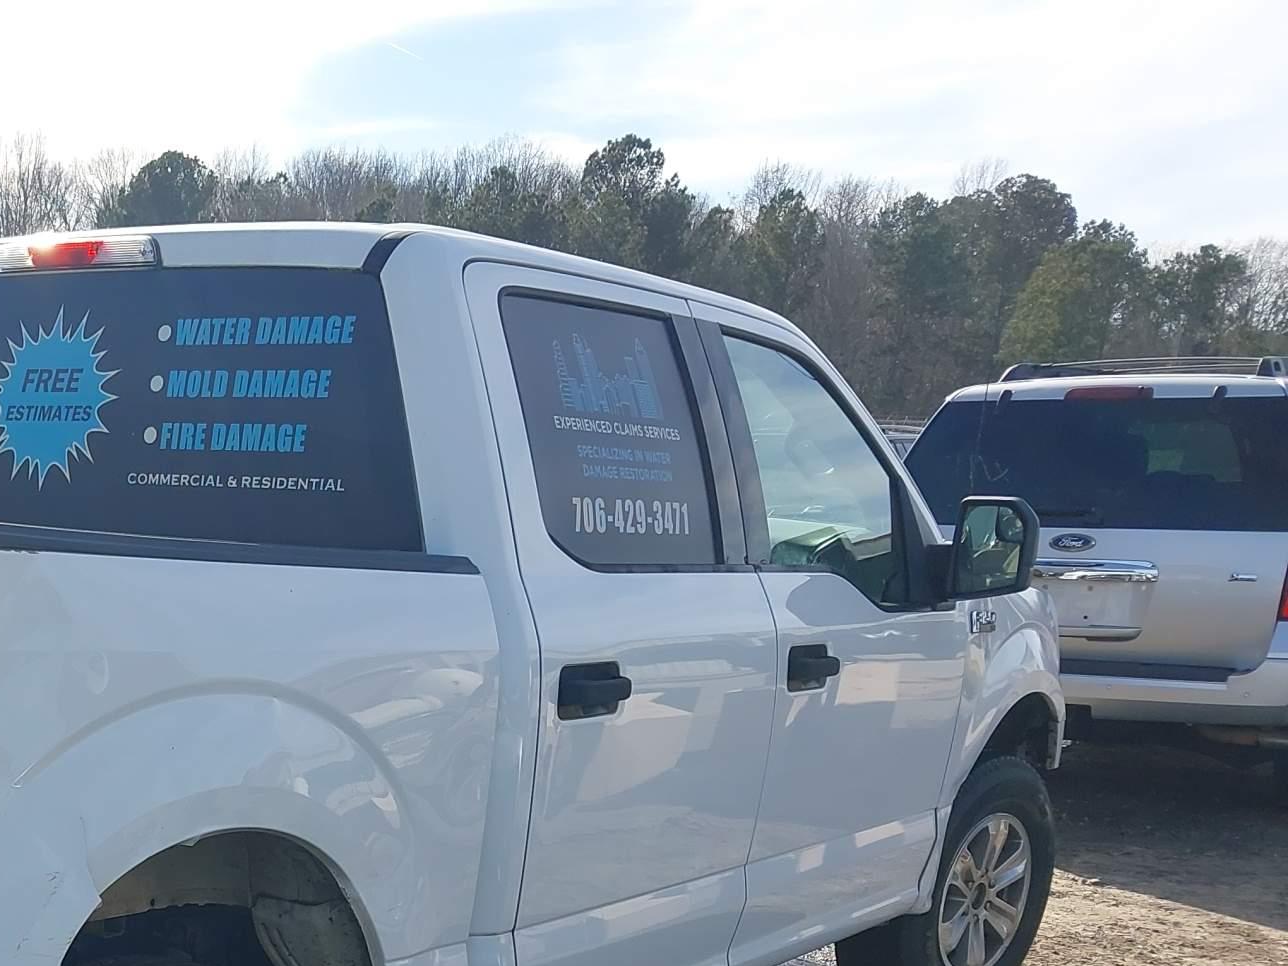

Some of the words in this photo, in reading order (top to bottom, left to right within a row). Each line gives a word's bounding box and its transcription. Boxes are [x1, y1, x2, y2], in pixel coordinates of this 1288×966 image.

[175, 317, 252, 346] WATER
[255, 315, 357, 345] DAMAGE
[21, 368, 85, 393] FREE
[166, 370, 229, 398] MOLD
[232, 370, 332, 398] DAMAGE
[5, 405, 93, 422] ESTIMATES
[159, 423, 207, 450] FIRE
[211, 424, 308, 453] DAMAGE
[553, 415, 612, 434] EXPERIENCED
[614, 422, 644, 437] CLAIMS
[644, 425, 681, 441] SERVICES
[127, 472, 223, 488] COMMERCIAL
[227, 475, 238, 488] &
[240, 476, 345, 492] RESIDENTIAL
[572, 496, 690, 536] 706-429-3471
